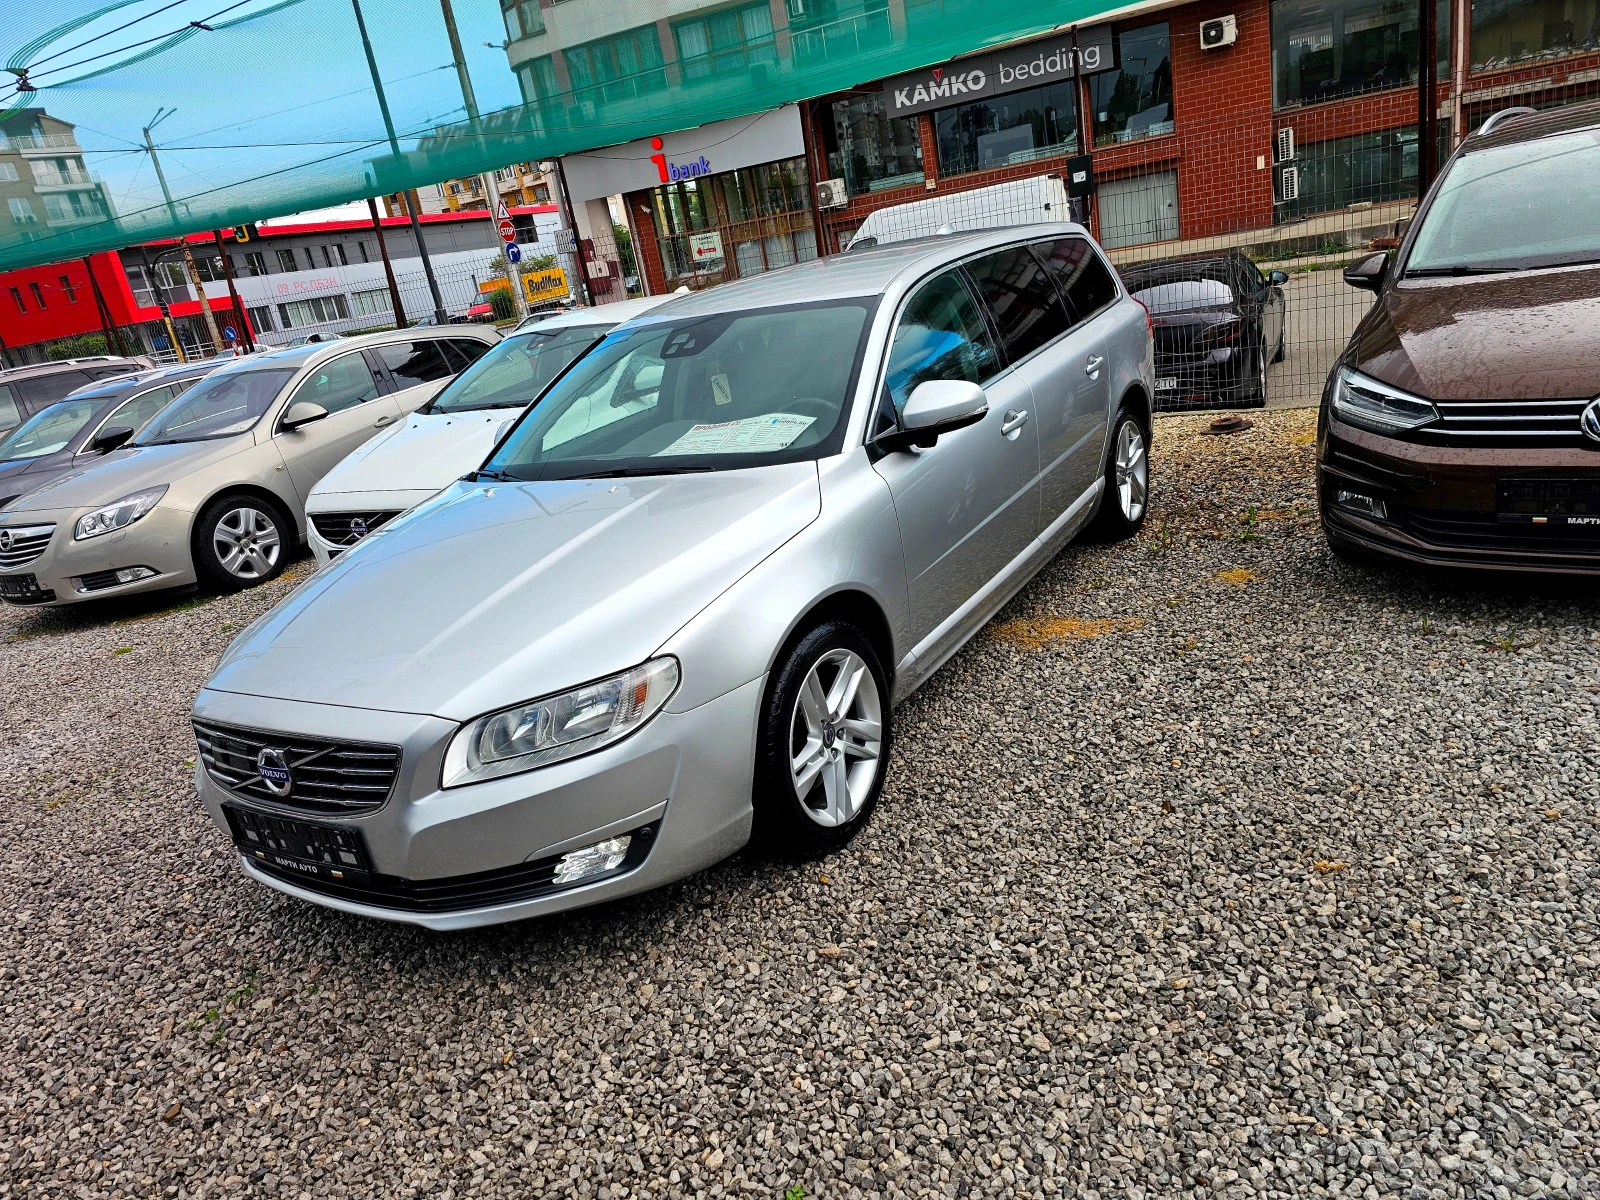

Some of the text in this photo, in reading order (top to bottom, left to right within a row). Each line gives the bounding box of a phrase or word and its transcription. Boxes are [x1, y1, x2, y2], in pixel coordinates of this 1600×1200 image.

[894, 45, 1100, 109] KAMKO bedding
[669, 156, 711, 180] bank
[501, 228, 514, 236] STOP
[528, 275, 563, 293] BudMax
[260, 768, 287, 779] VOLVO
